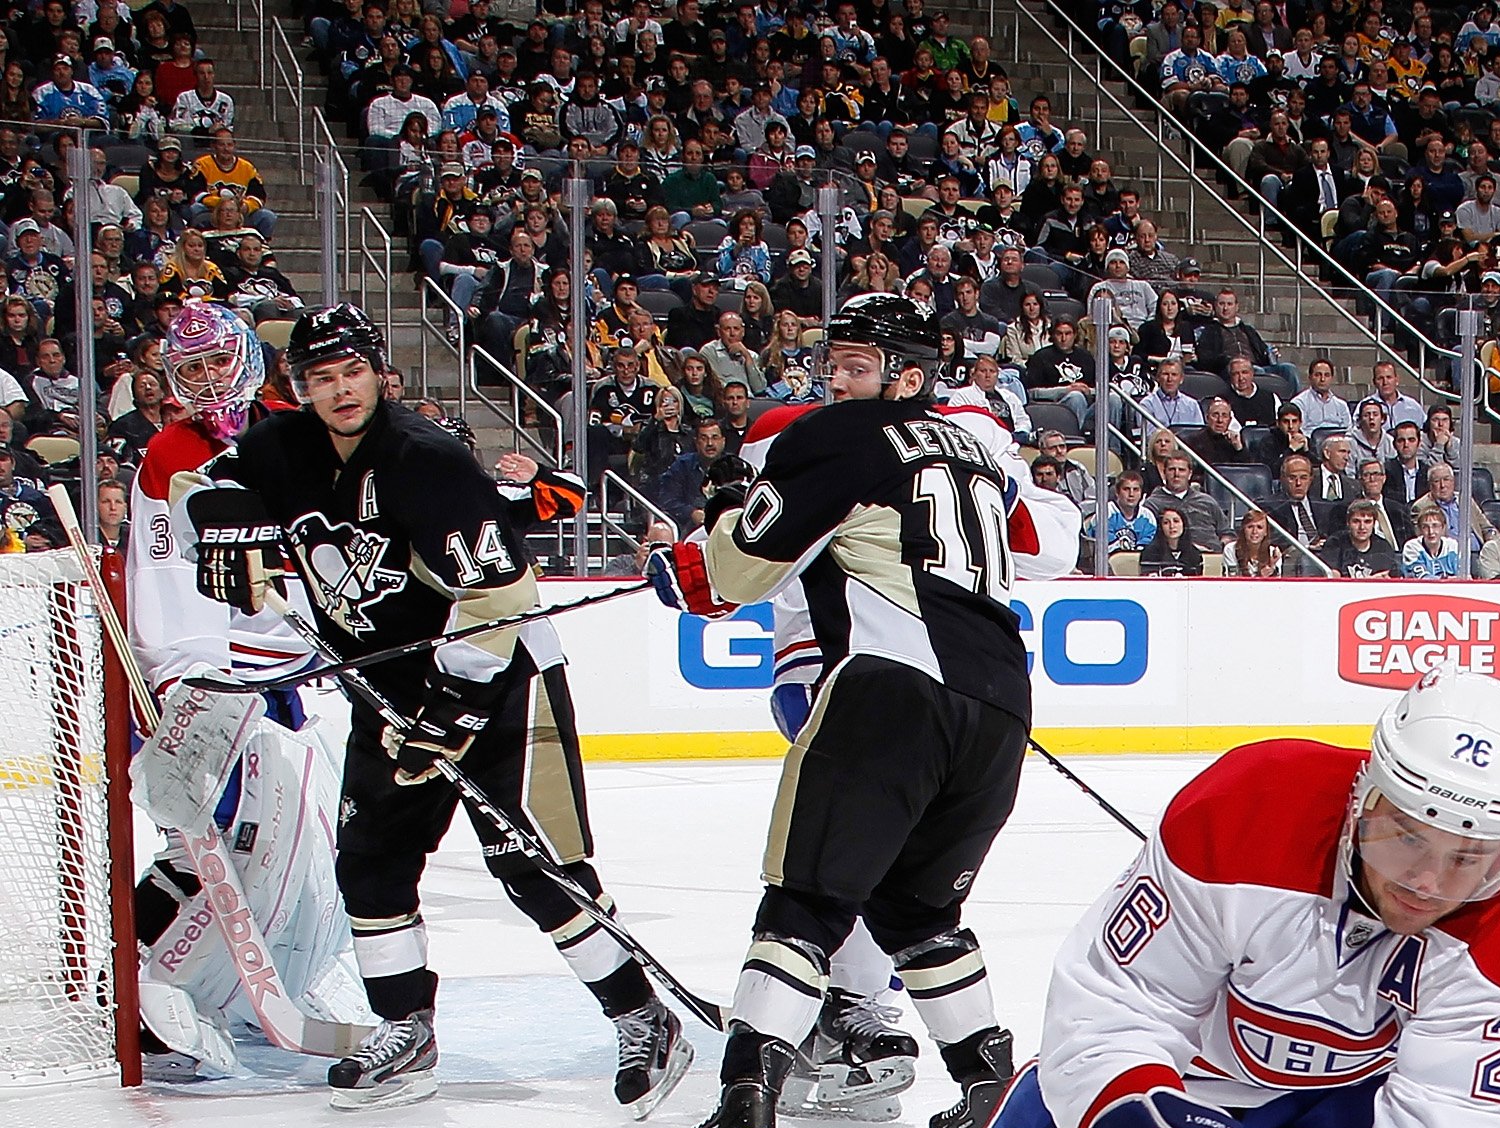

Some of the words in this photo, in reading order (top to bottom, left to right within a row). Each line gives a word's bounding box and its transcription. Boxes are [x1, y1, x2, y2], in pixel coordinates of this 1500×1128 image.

[359, 469, 379, 521] A
[446, 519, 516, 586] 14
[913, 463, 1013, 594] 10
[1353, 609, 1500, 642] GIANT
[1357, 643, 1496, 675] EAGLE
[1450, 733, 1494, 769] 26
[1427, 784, 1488, 811] BAUER
[158, 899, 215, 974] Reeb
[1103, 874, 1169, 966] 6
[1377, 934, 1427, 1014] A
